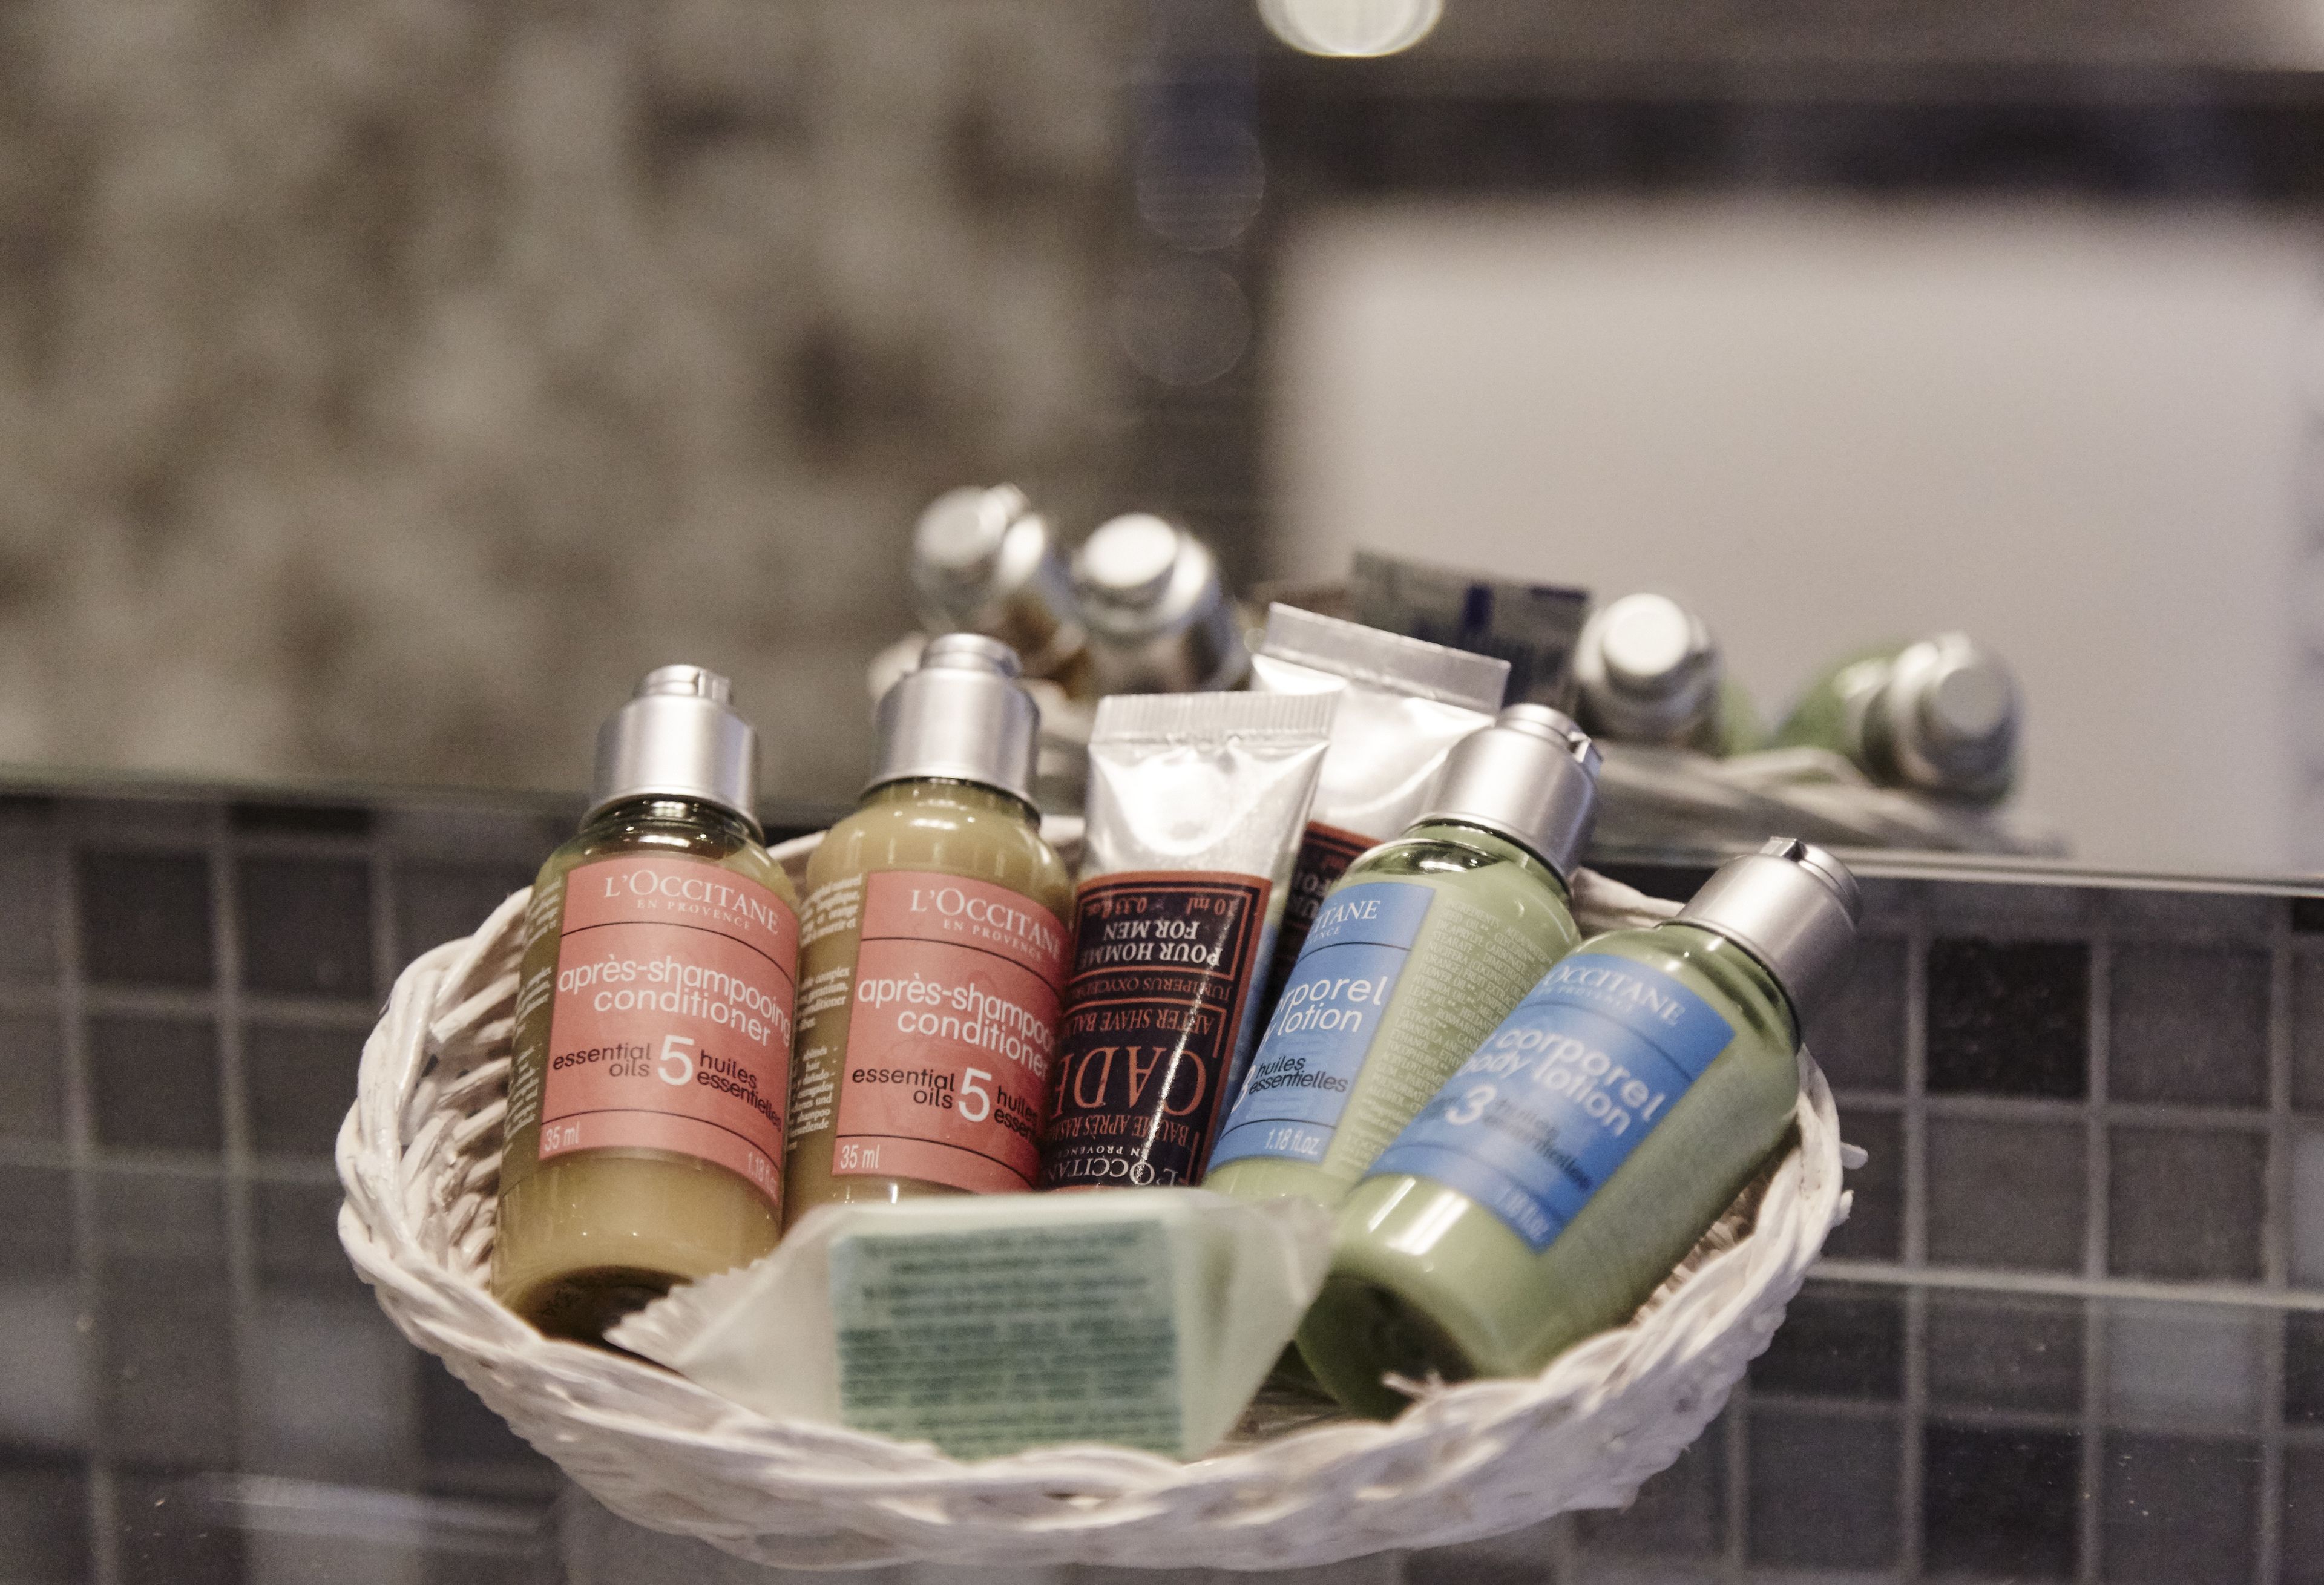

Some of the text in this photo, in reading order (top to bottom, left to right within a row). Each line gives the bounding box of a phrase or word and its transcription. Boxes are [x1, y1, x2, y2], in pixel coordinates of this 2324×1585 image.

[604, 870, 779, 935] L'OCCITANE
[637, 899, 750, 931] EN PROVENCE
[1186, 897, 1210, 916] ml
[944, 920, 1042, 960] EN PROVENCE
[1103, 920, 1201, 941] FOR MEN
[1158, 942, 1223, 967] POUR
[559, 953, 791, 1047] après-shampooing
[1142, 976, 1232, 1002] JUNIPERUS
[594, 983, 771, 1046] conditioner
[858, 973, 1054, 1054] après-shampoo
[1099, 1009, 1152, 1036] SHAVE
[1155, 1009, 1216, 1035] AFTER
[1278, 1002, 1362, 1036] lotion
[553, 1035, 757, 1089] essential 5 huiles
[1256, 1055, 1305, 1078] huiles
[1495, 1028, 1666, 1122] corporel
[609, 1059, 650, 1077] oils
[697, 1071, 781, 1132] essentielles
[852, 1069, 954, 1091] essential
[959, 1067, 992, 1122] 5
[997, 1085, 1037, 1123] huiles
[1249, 1070, 1348, 1095] essentielles
[1532, 1054, 1631, 1137] lotion
[913, 1089, 1037, 1141] oils essen
[1446, 1083, 1497, 1126] 3
[544, 1122, 580, 1151] 35 ml
[1083, 1114, 1131, 1140] APRÈS
[1134, 1115, 1190, 1146] BAUME
[1265, 1127, 1292, 1150] 1.18
[840, 1144, 879, 1169] 35 ml
